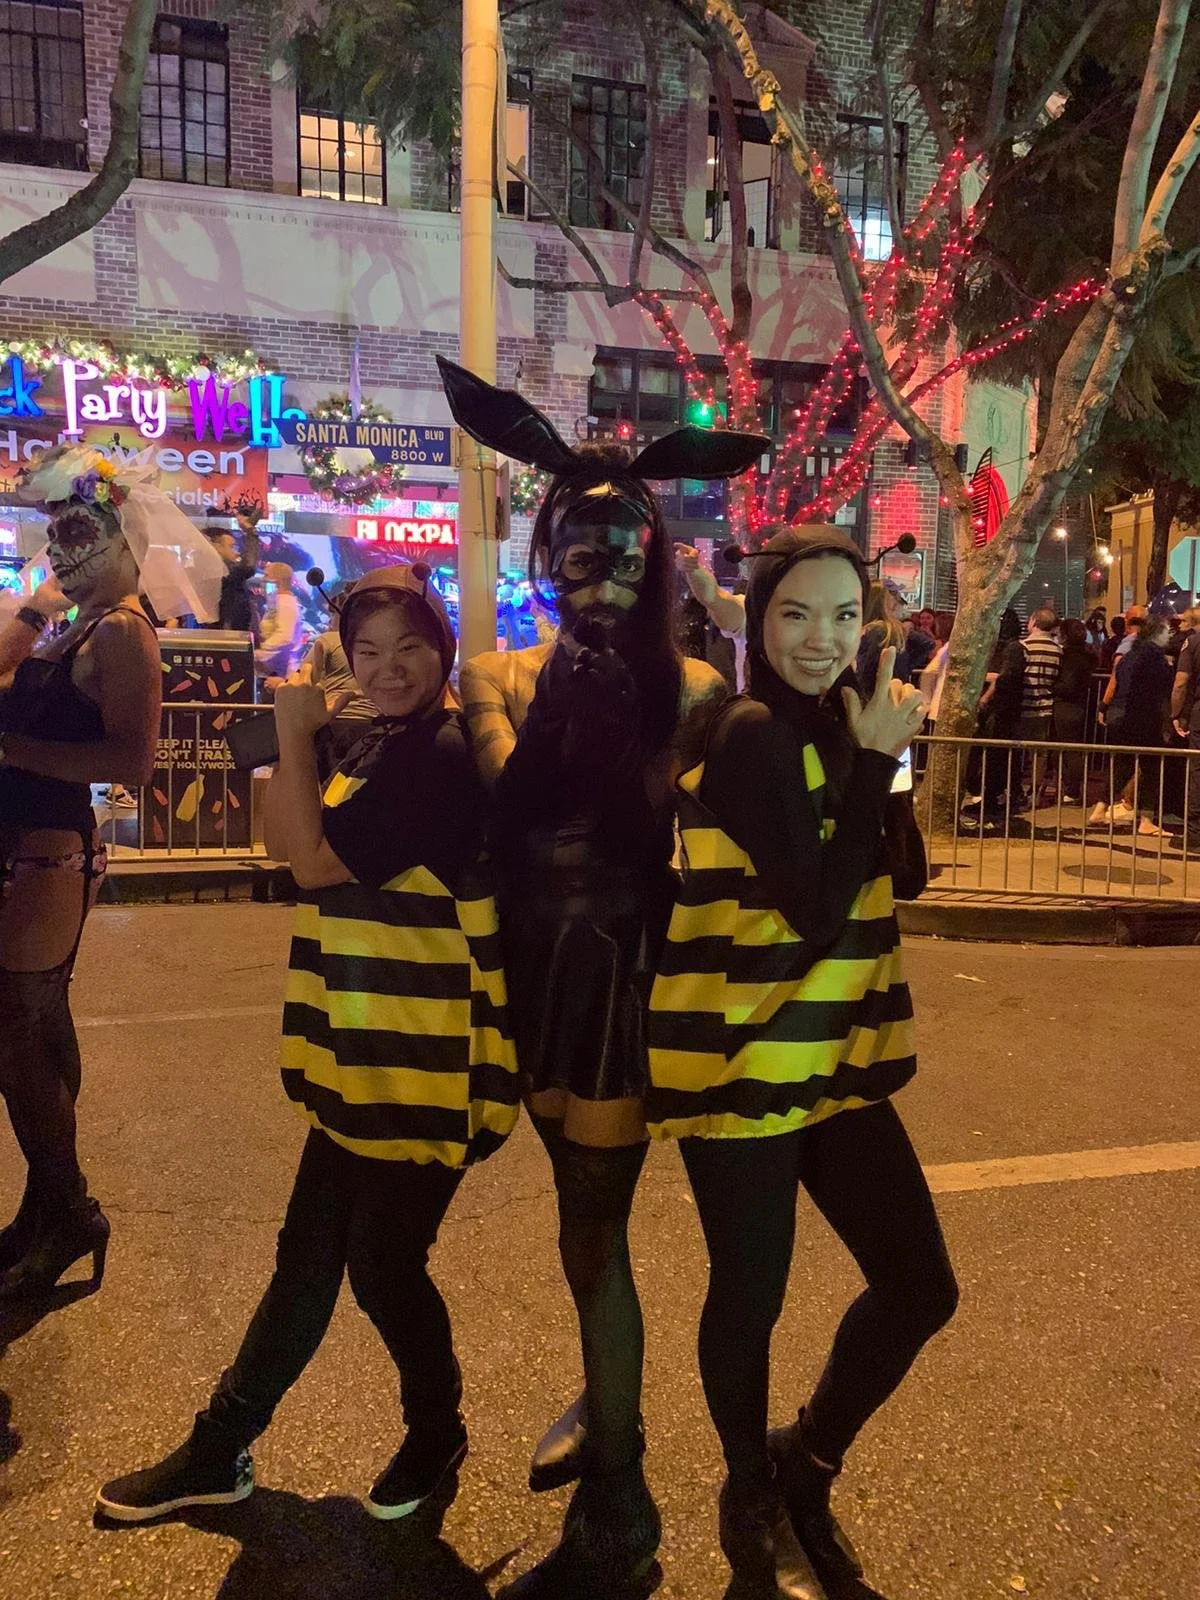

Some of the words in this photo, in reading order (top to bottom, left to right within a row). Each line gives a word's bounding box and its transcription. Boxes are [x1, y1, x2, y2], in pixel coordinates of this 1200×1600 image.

[55, 359, 167, 438] Party
[295, 422, 349, 444] SANTA
[356, 425, 419, 448] MONICA
[424, 429, 444, 441] BLVD
[391, 450, 427, 462] 8800
[432, 452, 444, 463] W
[156, 739, 180, 749] EEP
[182, 739, 194, 749] IT
[198, 739, 230, 749] CLEA
[154, 750, 191, 760] ON'T
